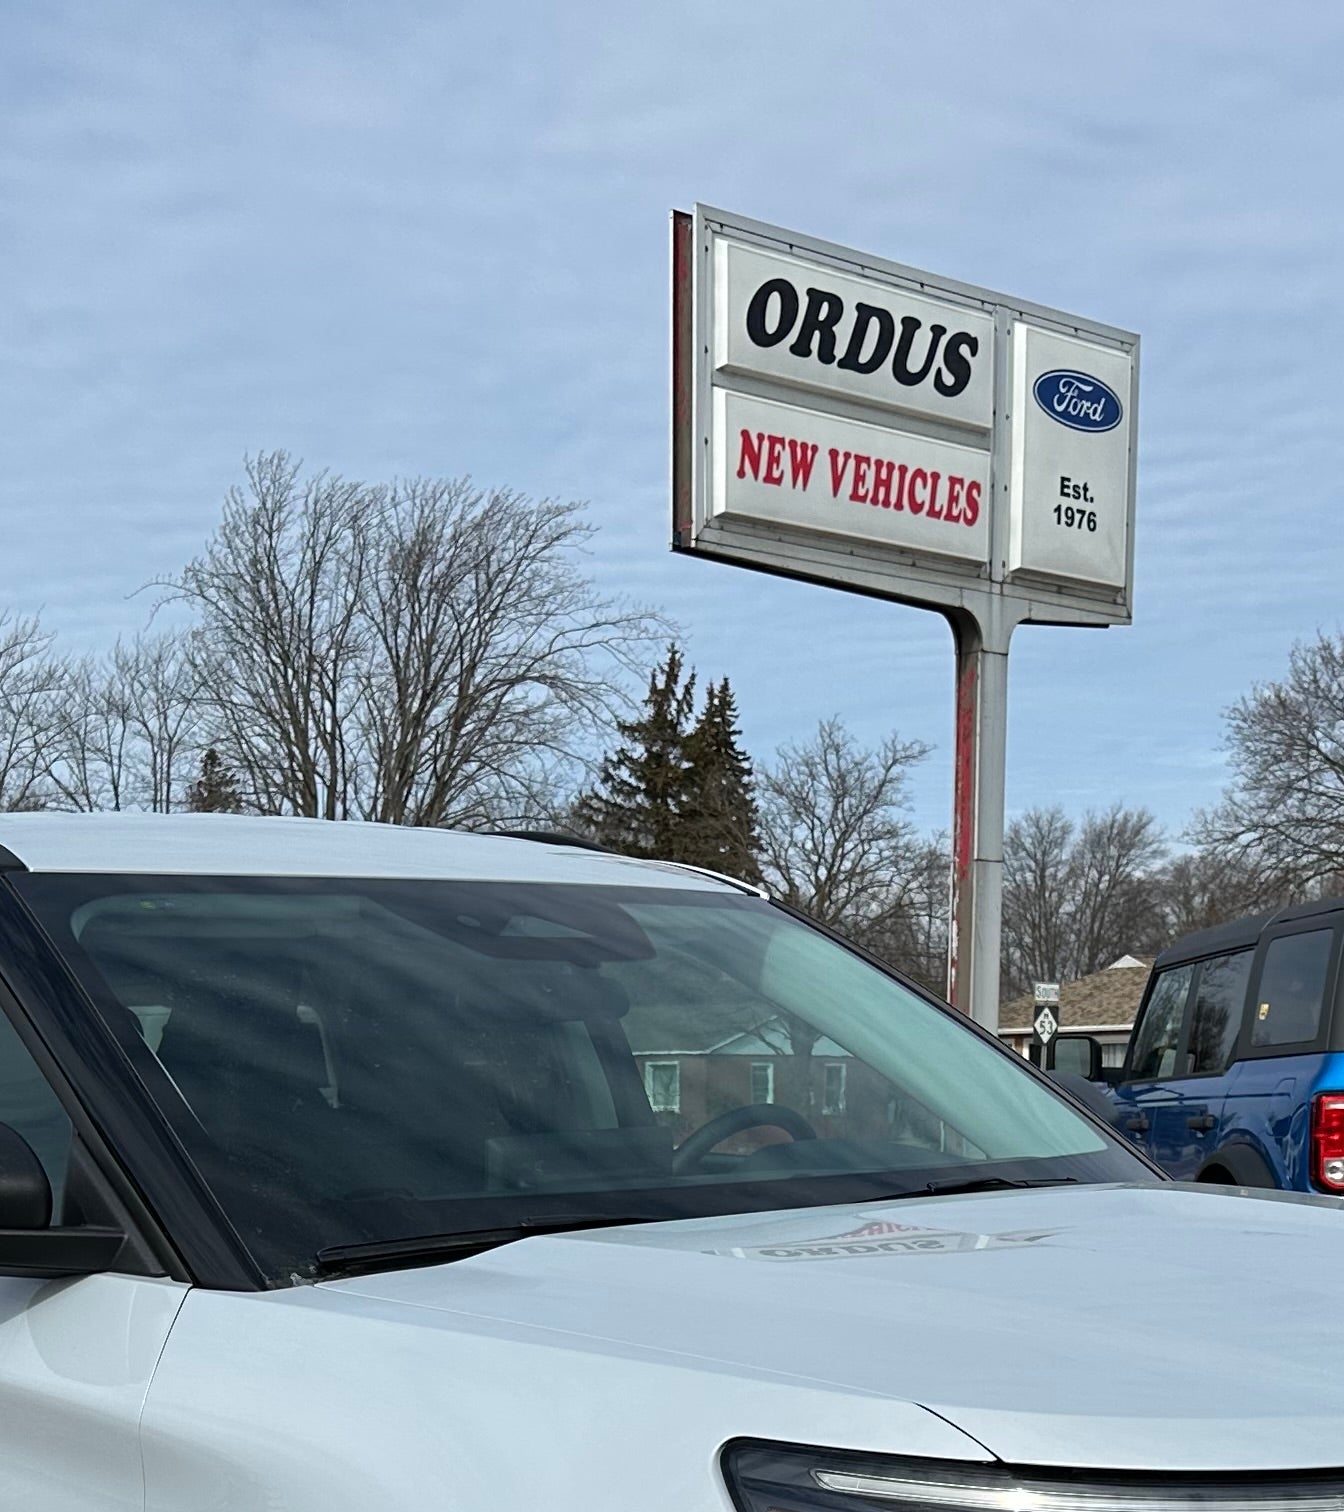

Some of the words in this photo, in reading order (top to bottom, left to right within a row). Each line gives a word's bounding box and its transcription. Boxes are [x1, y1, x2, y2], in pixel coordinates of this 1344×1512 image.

[746, 277, 979, 398] ORDUS
[1053, 377, 1106, 422] Ford
[736, 428, 819, 492] NEW
[828, 448, 982, 527] VEHICLES
[1059, 476, 1094, 503] Est.
[1053, 504, 1097, 532] 1976
[1039, 1020, 1054, 1035] 53
